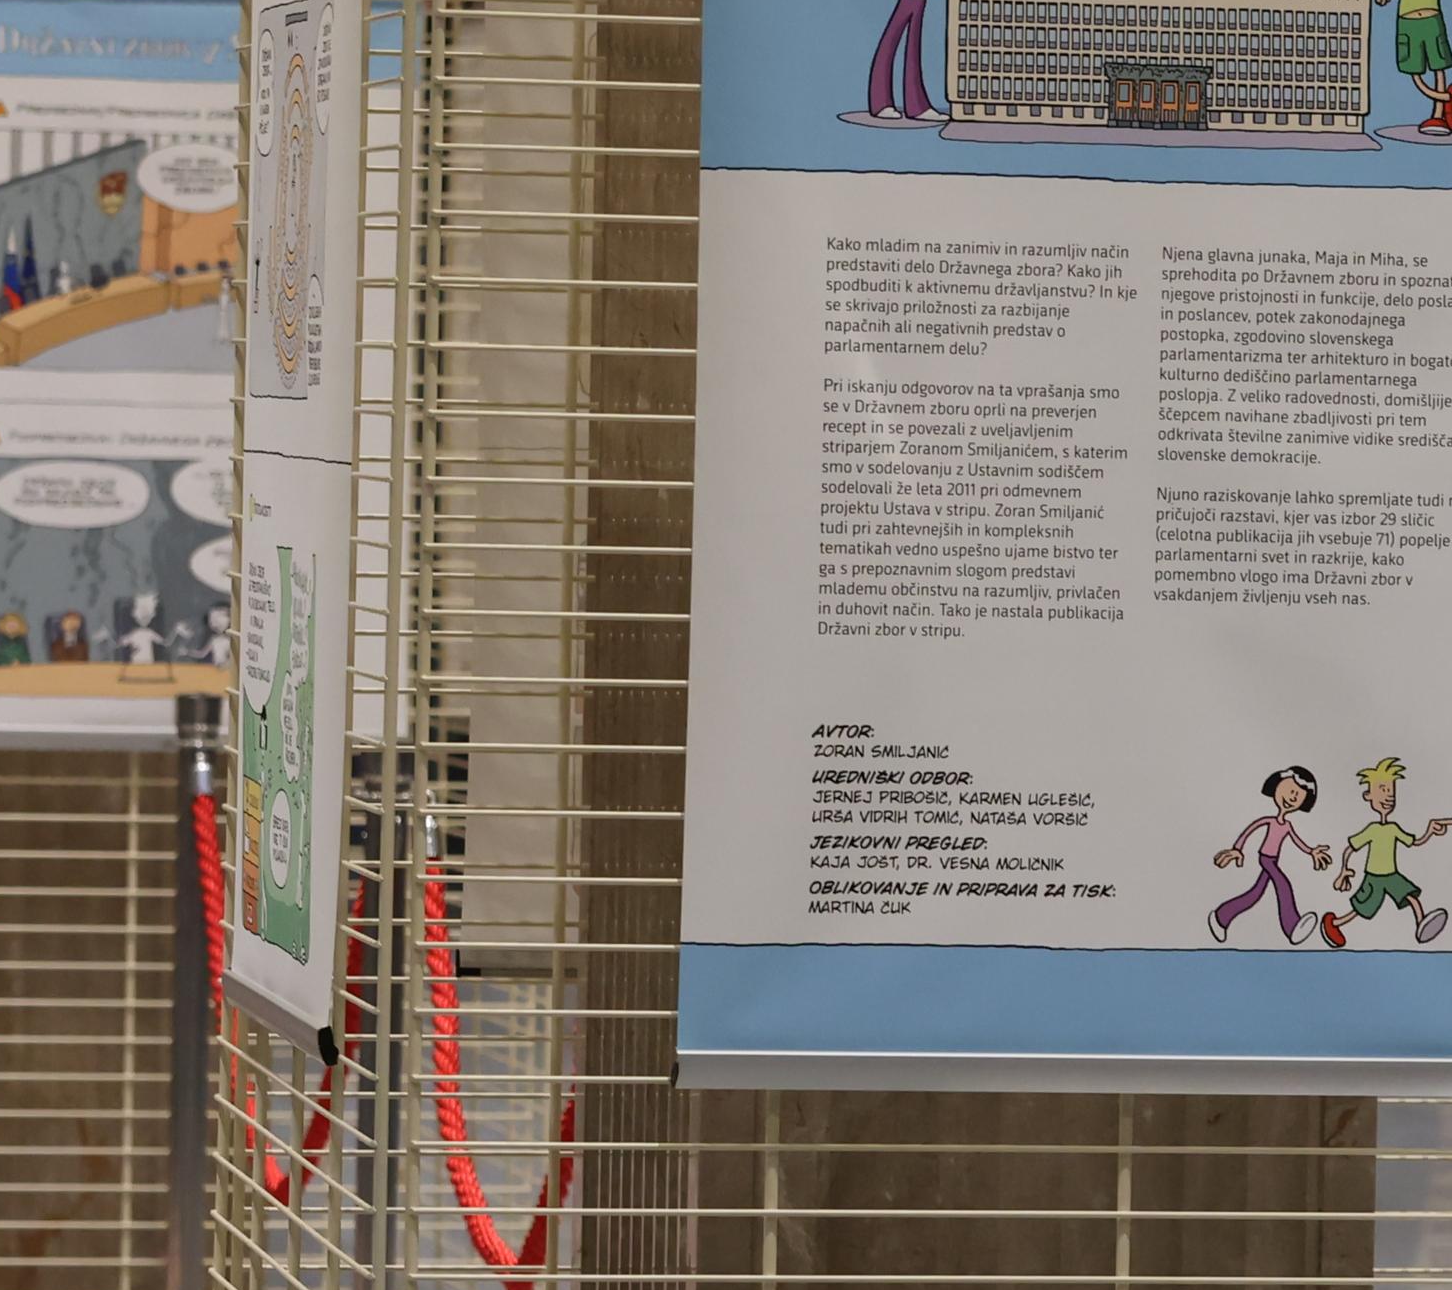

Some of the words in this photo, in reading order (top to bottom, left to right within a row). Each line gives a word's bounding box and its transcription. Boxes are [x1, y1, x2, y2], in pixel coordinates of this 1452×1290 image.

[827, 236, 861, 251] Kako
[865, 237, 920, 252] mladim
[924, 242, 941, 253] na
[946, 241, 1001, 255] zanimiv
[1004, 241, 1017, 255] in
[1021, 243, 1087, 260] razumljiv
[1091, 244, 1129, 258] način
[1162, 245, 1203, 263] Njena
[1207, 247, 1254, 264] glavna
[1258, 249, 1310, 266] junaka,
[1315, 250, 1348, 268] Maja
[1352, 252, 1365, 265] in
[1370, 251, 1408, 268] Miha,
[1412, 256, 1428, 267] se
[826, 257, 900, 273] predstaviti
[904, 259, 935, 273] delo
[939, 259, 1012, 279] Državnega
[1016, 262, 1063, 277] zbora?
[1067, 263, 1101, 278] Kako
[1104, 264, 1122, 281] jih
[1161, 267, 1236, 283] sprehodita
[1241, 271, 1259, 285] po
[1263, 268, 1335, 284] Državnem
[1338, 271, 1379, 286] zboru
[1383, 272, 1396, 286] in
[1161, 289, 1215, 304] njegove
[1219, 288, 1298, 305] pristojnosti
[1303, 290, 1316, 303] in
[1320, 290, 1379, 308] funkcije,
[1383, 292, 1413, 307] delo
[825, 300, 841, 311] se
[845, 298, 899, 315] skrivajo
[903, 300, 976, 316] priložnosti
[980, 304, 996, 315] za
[1001, 303, 1070, 321] razbijanje
[1160, 306, 1173, 320] in
[1177, 307, 1251, 323] poslancev,
[1256, 310, 1295, 325] potek
[1299, 311, 1405, 330] zakonodajnega
[824, 338, 945, 354] parlamentarnem
[948, 341, 988, 356] delu?
[1160, 327, 1229, 344] postopka,
[1233, 329, 1305, 346] zgodovino
[1309, 330, 1394, 349] slovenskega
[1159, 347, 1282, 363] parlamentarizma
[1287, 351, 1307, 364] ter
[1310, 351, 1389, 366] arhitekturo
[1393, 352, 1406, 366] in
[1159, 366, 1219, 382] kulturno
[1223, 368, 1291, 383] dediščino
[1295, 370, 1417, 390] parlamentarnega
[823, 377, 843, 392] Pri
[847, 379, 897, 396] iskanju
[901, 380, 974, 398] odgovorov
[977, 385, 994, 396] na
[998, 384, 1013, 396] ta
[1016, 383, 1085, 401] vprašanja
[1089, 387, 1120, 399] smo
[1158, 406, 1220, 424] ščepcem
[1225, 409, 1289, 423] navihane
[1293, 410, 1372, 427] zbadljivosti
[1376, 412, 1395, 428] pri
[1399, 414, 1427, 426] tem
[1157, 427, 1223, 442] odkrivata
[1228, 428, 1282, 443] številne
[1286, 430, 1349, 445] zanimive
[1353, 431, 1394, 446] vidike
[1157, 446, 1226, 462] slovenske
[1230, 448, 1321, 466] demokracije.
[821, 480, 892, 495] sodelovali
[896, 481, 912, 495] že
[916, 481, 942, 496] leta
[946, 482, 975, 496] 2011
[980, 485, 998, 499] pri
[1002, 484, 1082, 498] odmevnem
[1156, 486, 1199, 503] Njuno
[1203, 488, 1291, 506] raziskovanje
[1295, 490, 1334, 504] lahko
[1338, 492, 1413, 508] spremljate
[1417, 493, 1444, 507] tudi
[1155, 507, 1216, 524] pričujoči
[1220, 509, 1279, 524] razstavi,
[1283, 509, 1310, 526] kjer
[1313, 513, 1337, 525] vas
[1341, 511, 1376, 526] izbor
[1379, 511, 1397, 526] 29
[1400, 512, 1435, 527] sličic
[819, 540, 892, 555] tematikah
[895, 542, 938, 556] vedno
[942, 543, 1000, 559] uspešno
[1004, 543, 1049, 560] ujame
[1053, 544, 1095, 559] bistvo
[1098, 546, 1119, 560] ter
[1155, 547, 1257, 563] parlamentarni
[1261, 551, 1289, 564] svet
[1294, 549, 1307, 563] in
[1311, 551, 1367, 568] razkrije,
[1372, 551, 1405, 566] kako
[818, 581, 887, 595] mlademu
[891, 582, 958, 596] občinstvu
[962, 586, 979, 597] na
[984, 584, 1052, 601] razumljiv,
[1056, 585, 1120, 601] privlačen
[818, 600, 831, 614] in
[835, 601, 888, 616] duhovit
[892, 602, 934, 616] način.
[941, 602, 971, 617] Tako
[974, 606, 987, 620] je
[991, 604, 1043, 618] nastala
[1048, 604, 1124, 622] publikacija
[811, 723, 874, 739] AVTOR:
[813, 743, 865, 758] ZORAN
[870, 744, 949, 759] SMILJANIĆ
[811, 769, 905, 784] UREDNIŠKI
[909, 770, 973, 785] ODBOR:
[812, 789, 872, 803] JERNEJ
[879, 790, 952, 805] PRIBOŠIČ,
[959, 791, 1022, 805] KARMEN
[1027, 792, 1095, 808] UGLEŠIĆ,
[811, 809, 853, 823] URŠA
[859, 809, 908, 823] VIDRIH
[914, 810, 963, 825] TOMIĆ,
[970, 811, 1027, 825] NATAŠA
[1032, 812, 1088, 826] VORŠIČ
[809, 835, 902, 849] JEZIKOVNI
[904, 835, 987, 851] PREGLED:
[810, 855, 850, 868] KAJA
[856, 855, 899, 870] JOŠT,
[907, 855, 932, 869] DR.
[939, 856, 990, 870] VESNA
[995, 857, 1064, 871] MOLIČNIK
[809, 880, 929, 896] OBLIKOVANJE
[932, 882, 953, 895] IN
[955, 882, 1038, 897] PRIPRAVA
[1043, 883, 1066, 897] ZA
[1072, 883, 1116, 898] TISK:
[807, 900, 875, 914] MARTINA
[880, 900, 911, 914] ČUK
